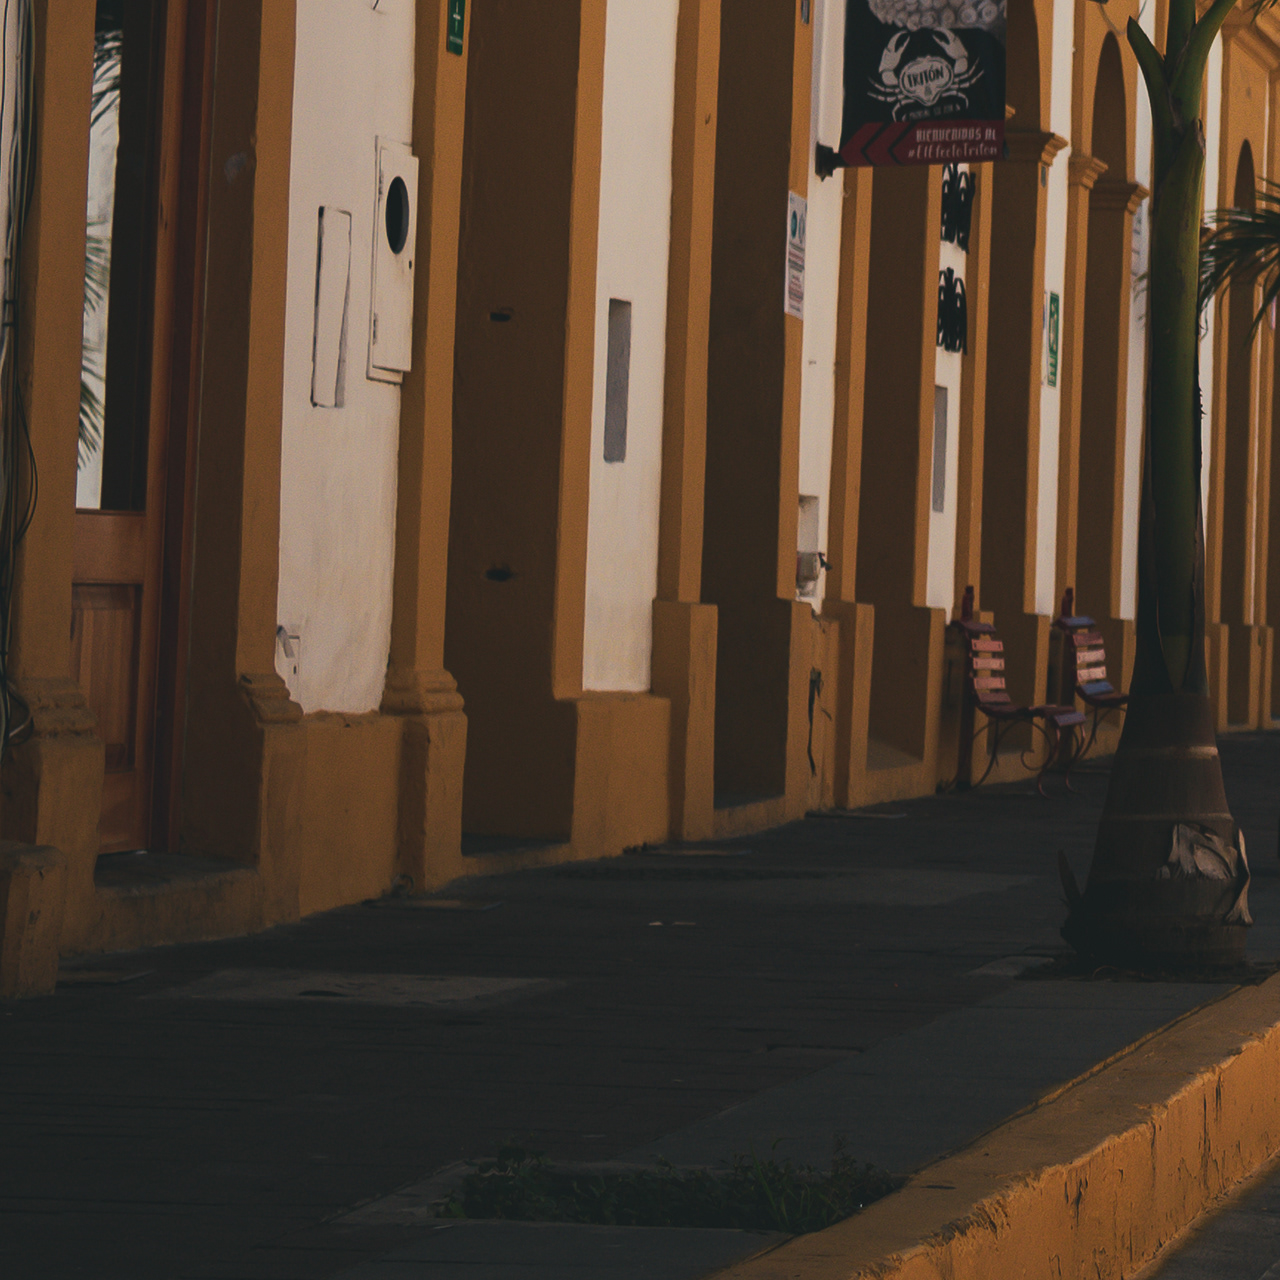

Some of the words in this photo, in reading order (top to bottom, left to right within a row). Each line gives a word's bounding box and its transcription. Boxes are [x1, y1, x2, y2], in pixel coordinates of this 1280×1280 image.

[907, 64, 944, 88] TRITÓN
[915, 127, 982, 143] BIENVENIDOS
[985, 127, 997, 141] AL
